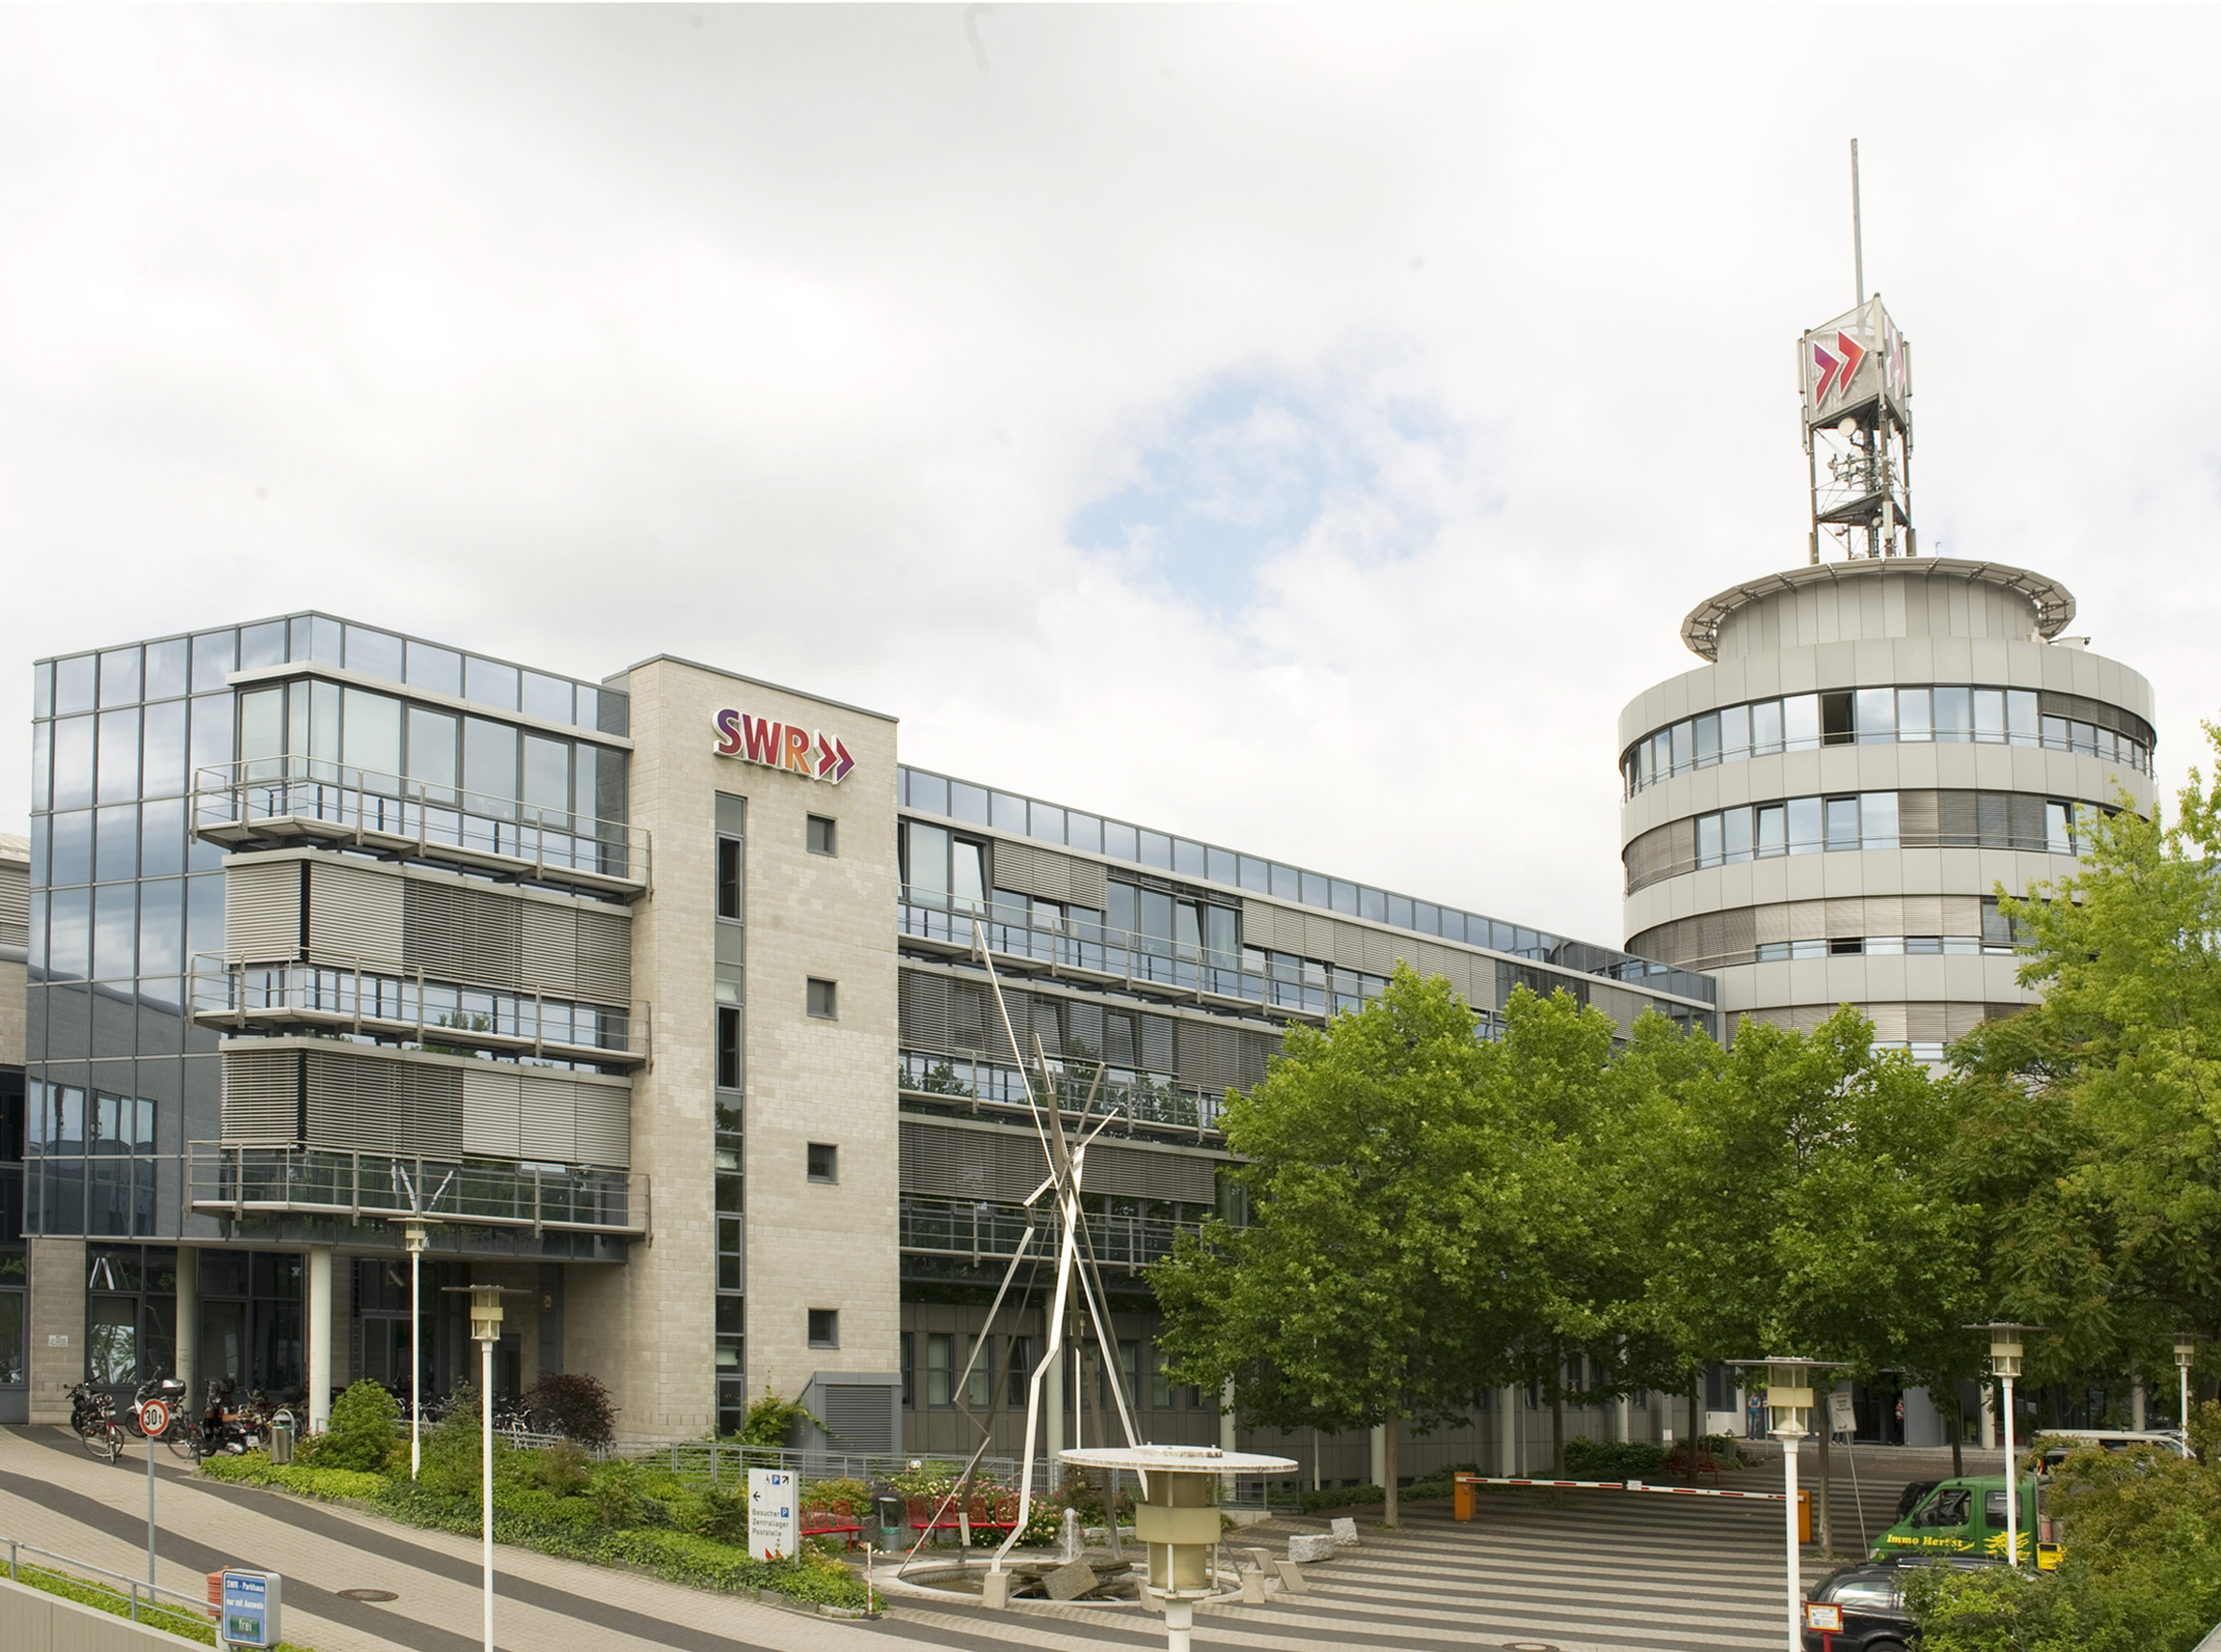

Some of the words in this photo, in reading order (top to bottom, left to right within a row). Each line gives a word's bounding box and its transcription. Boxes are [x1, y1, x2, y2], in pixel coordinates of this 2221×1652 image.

[713, 708, 812, 775] SWR
[752, 1518, 789, 1529] Zentrallager
[752, 1528, 782, 1536] Poststelle
[1886, 1533, 1919, 1545] Immo
[226, 1580, 239, 1589] SWR
[242, 1582, 264, 1592] Parkhaus
[238, 1618, 253, 1632] frei
